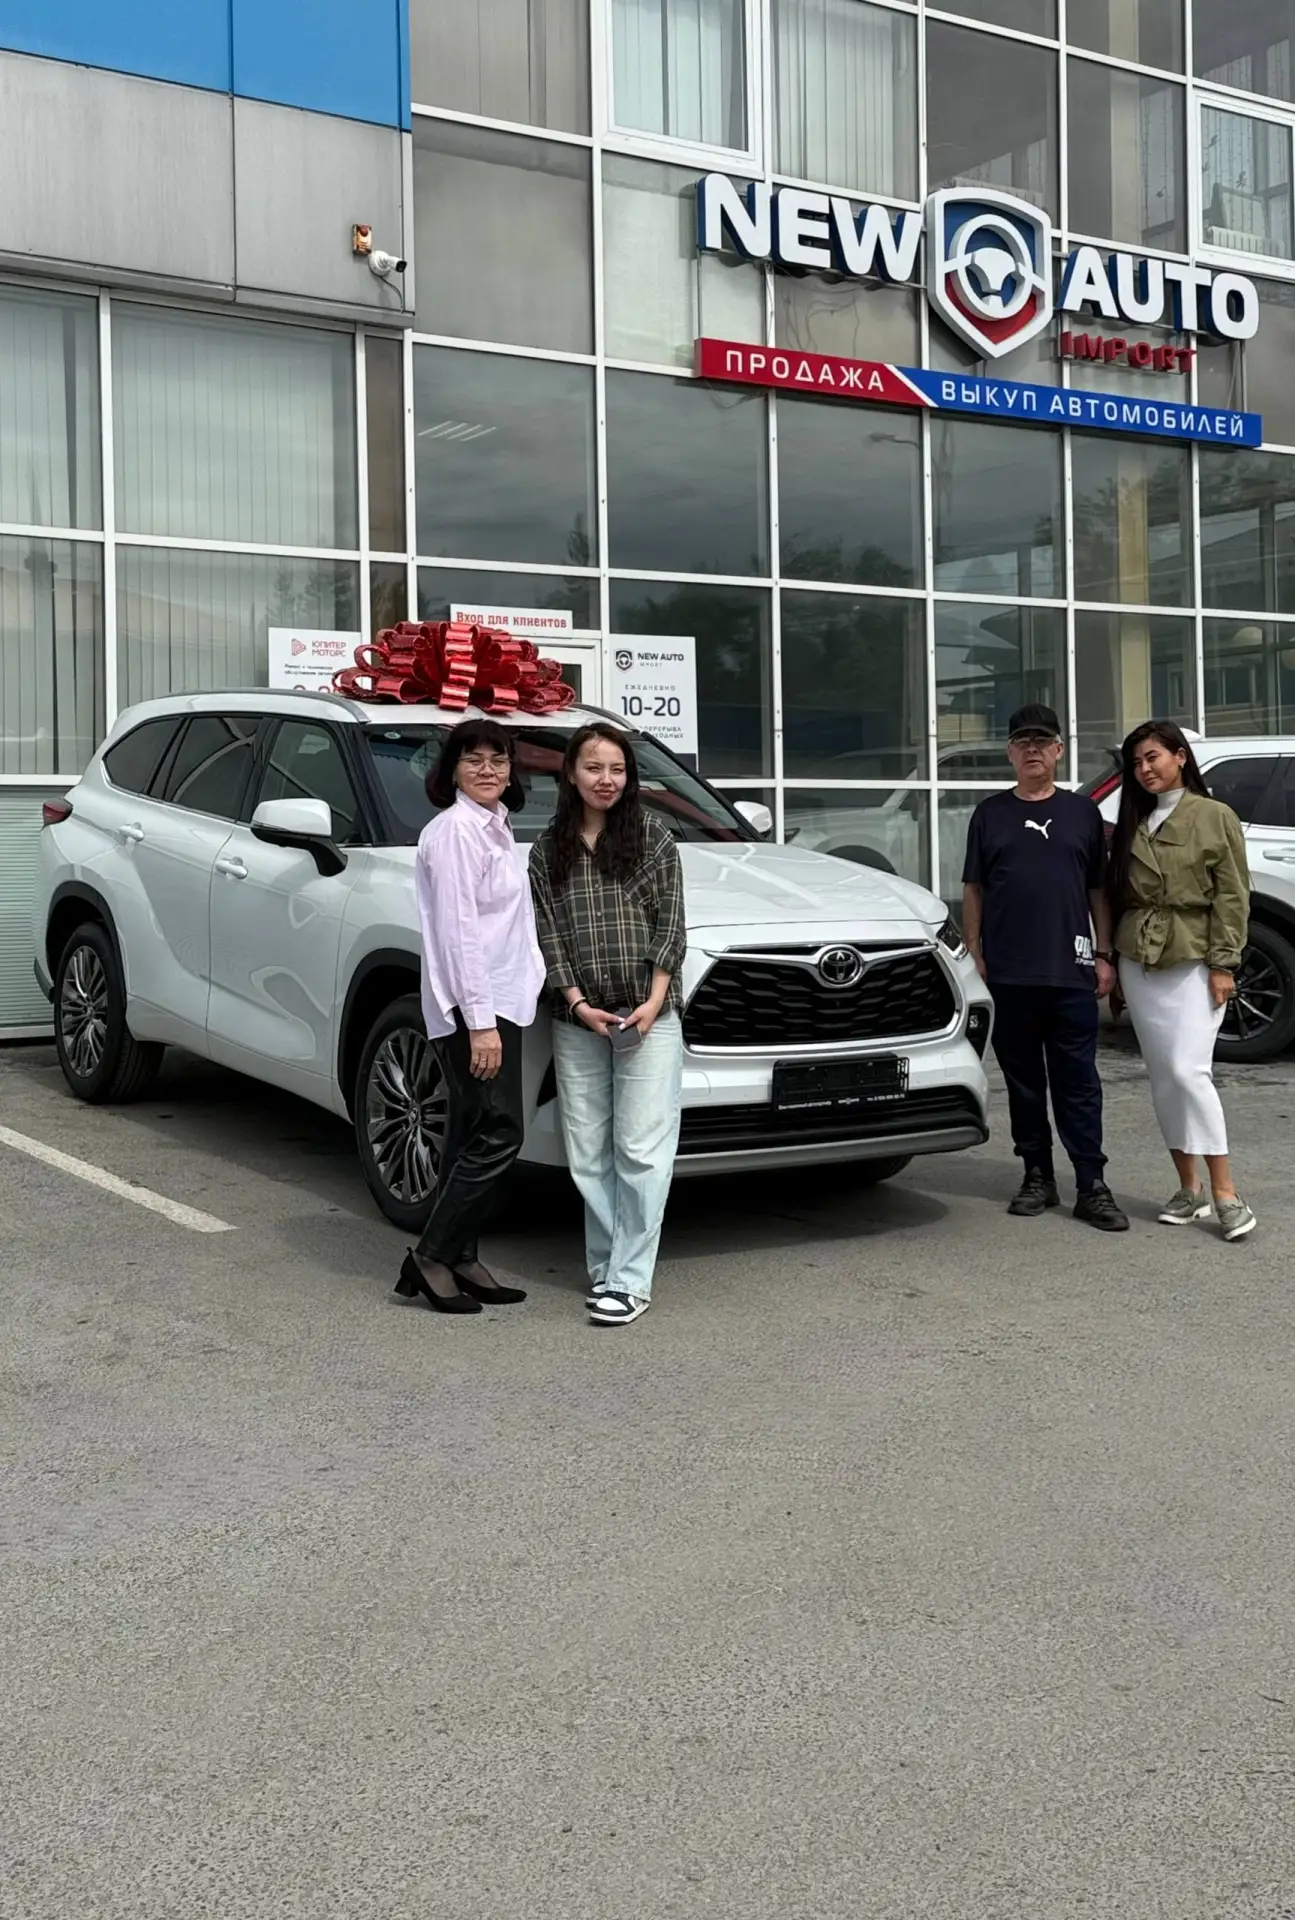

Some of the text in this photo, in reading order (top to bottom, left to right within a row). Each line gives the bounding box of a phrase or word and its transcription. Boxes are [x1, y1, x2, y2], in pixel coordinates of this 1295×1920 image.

[698, 172, 1260, 341] NEW AUTO
[1060, 331, 1196, 373] IMPORT
[725, 350, 885, 393] ПРОДАЖА
[942, 379, 1245, 439] ВЫКУП АВТОМОБИЛЕЙ
[456, 611, 567, 628] Вход для клиентов
[312, 640, 346, 649] ЮПИТЕР
[312, 649, 346, 657] МОТОРС
[637, 652, 684, 661] NEW AUTO
[621, 695, 681, 717] 10-20
